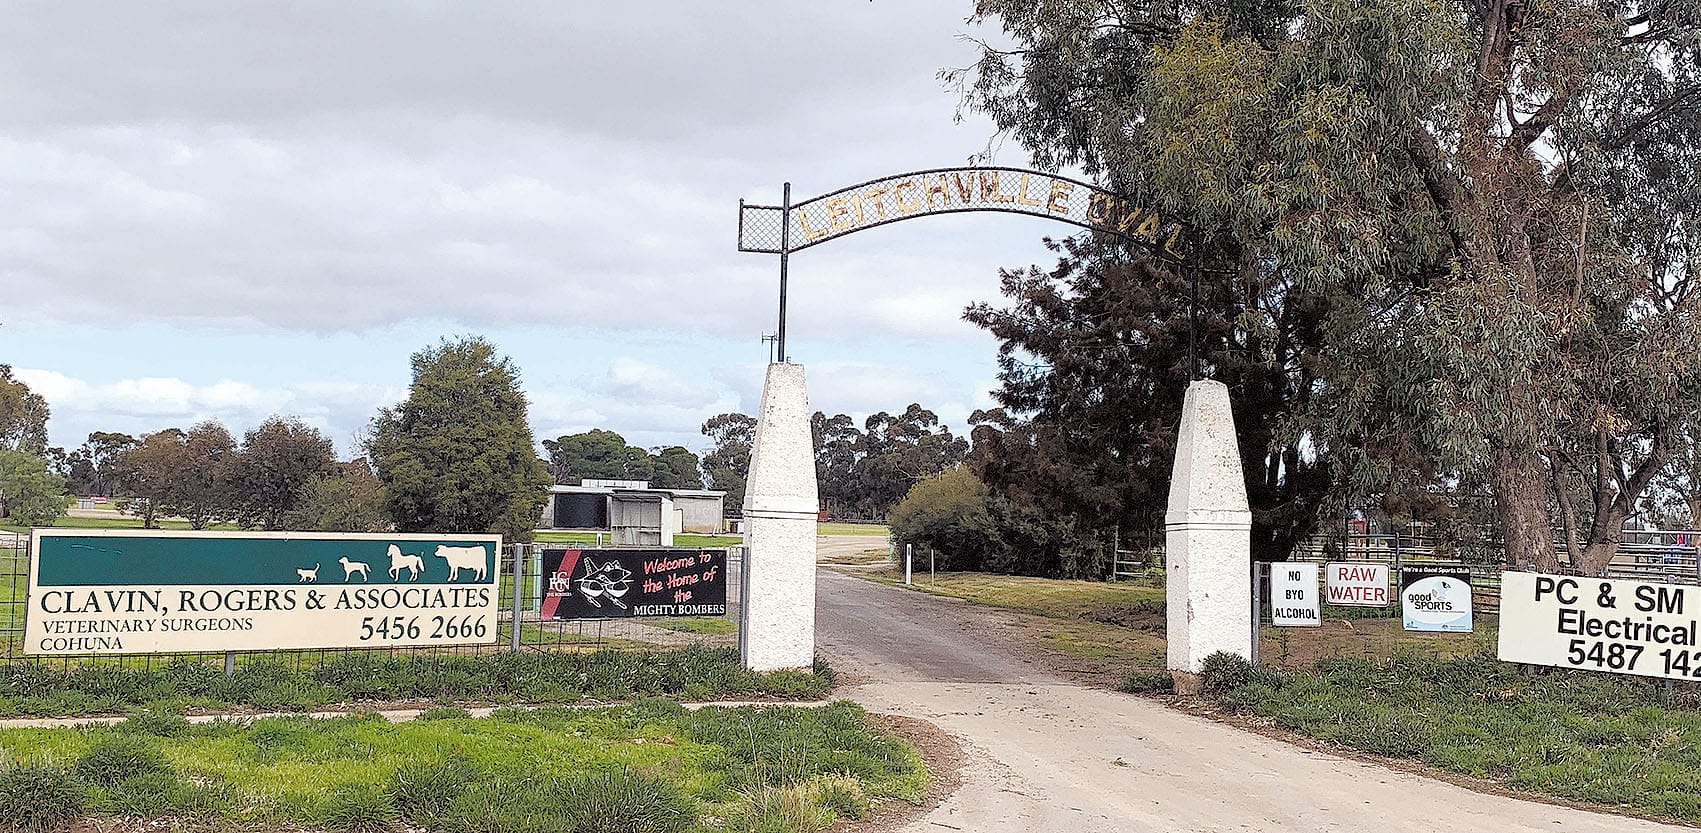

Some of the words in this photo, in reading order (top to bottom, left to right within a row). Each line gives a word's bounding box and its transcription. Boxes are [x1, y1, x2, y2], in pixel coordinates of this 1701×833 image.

[798, 171, 1075, 241] LEITCHVILLE
[1087, 193, 1187, 260] OVAL
[644, 556, 695, 574] Welcome
[699, 551, 711, 564] to
[643, 580, 662, 593] the
[666, 573, 699, 589] Home
[703, 565, 718, 582] of
[1288, 570, 1301, 581] NO
[1338, 567, 1377, 582] RAW
[40, 589, 169, 617] CLAVIN,
[178, 589, 296, 613] ROGERS
[305, 590, 326, 610] &
[335, 587, 490, 611] ASSOCIATES
[674, 590, 693, 604] the
[1285, 589, 1303, 600] BYO
[1329, 586, 1385, 602] WATER
[1408, 593, 1431, 603] good
[1535, 576, 1579, 605] PC
[1596, 582, 1617, 608] &
[1634, 585, 1684, 614] SM
[633, 605, 676, 616] MIGHTY
[678, 604, 725, 615] BOMBERS
[1414, 601, 1452, 610] SPORTS
[1274, 608, 1317, 620] ALCOHOL
[42, 618, 156, 634] VETERINARY
[160, 617, 253, 632] SURGEONS
[359, 616, 420, 641] 5456
[430, 615, 487, 639] 2666
[1557, 608, 1697, 646] Electrical
[39, 637, 123, 651] COHUNA
[1567, 639, 1644, 670] 5487
